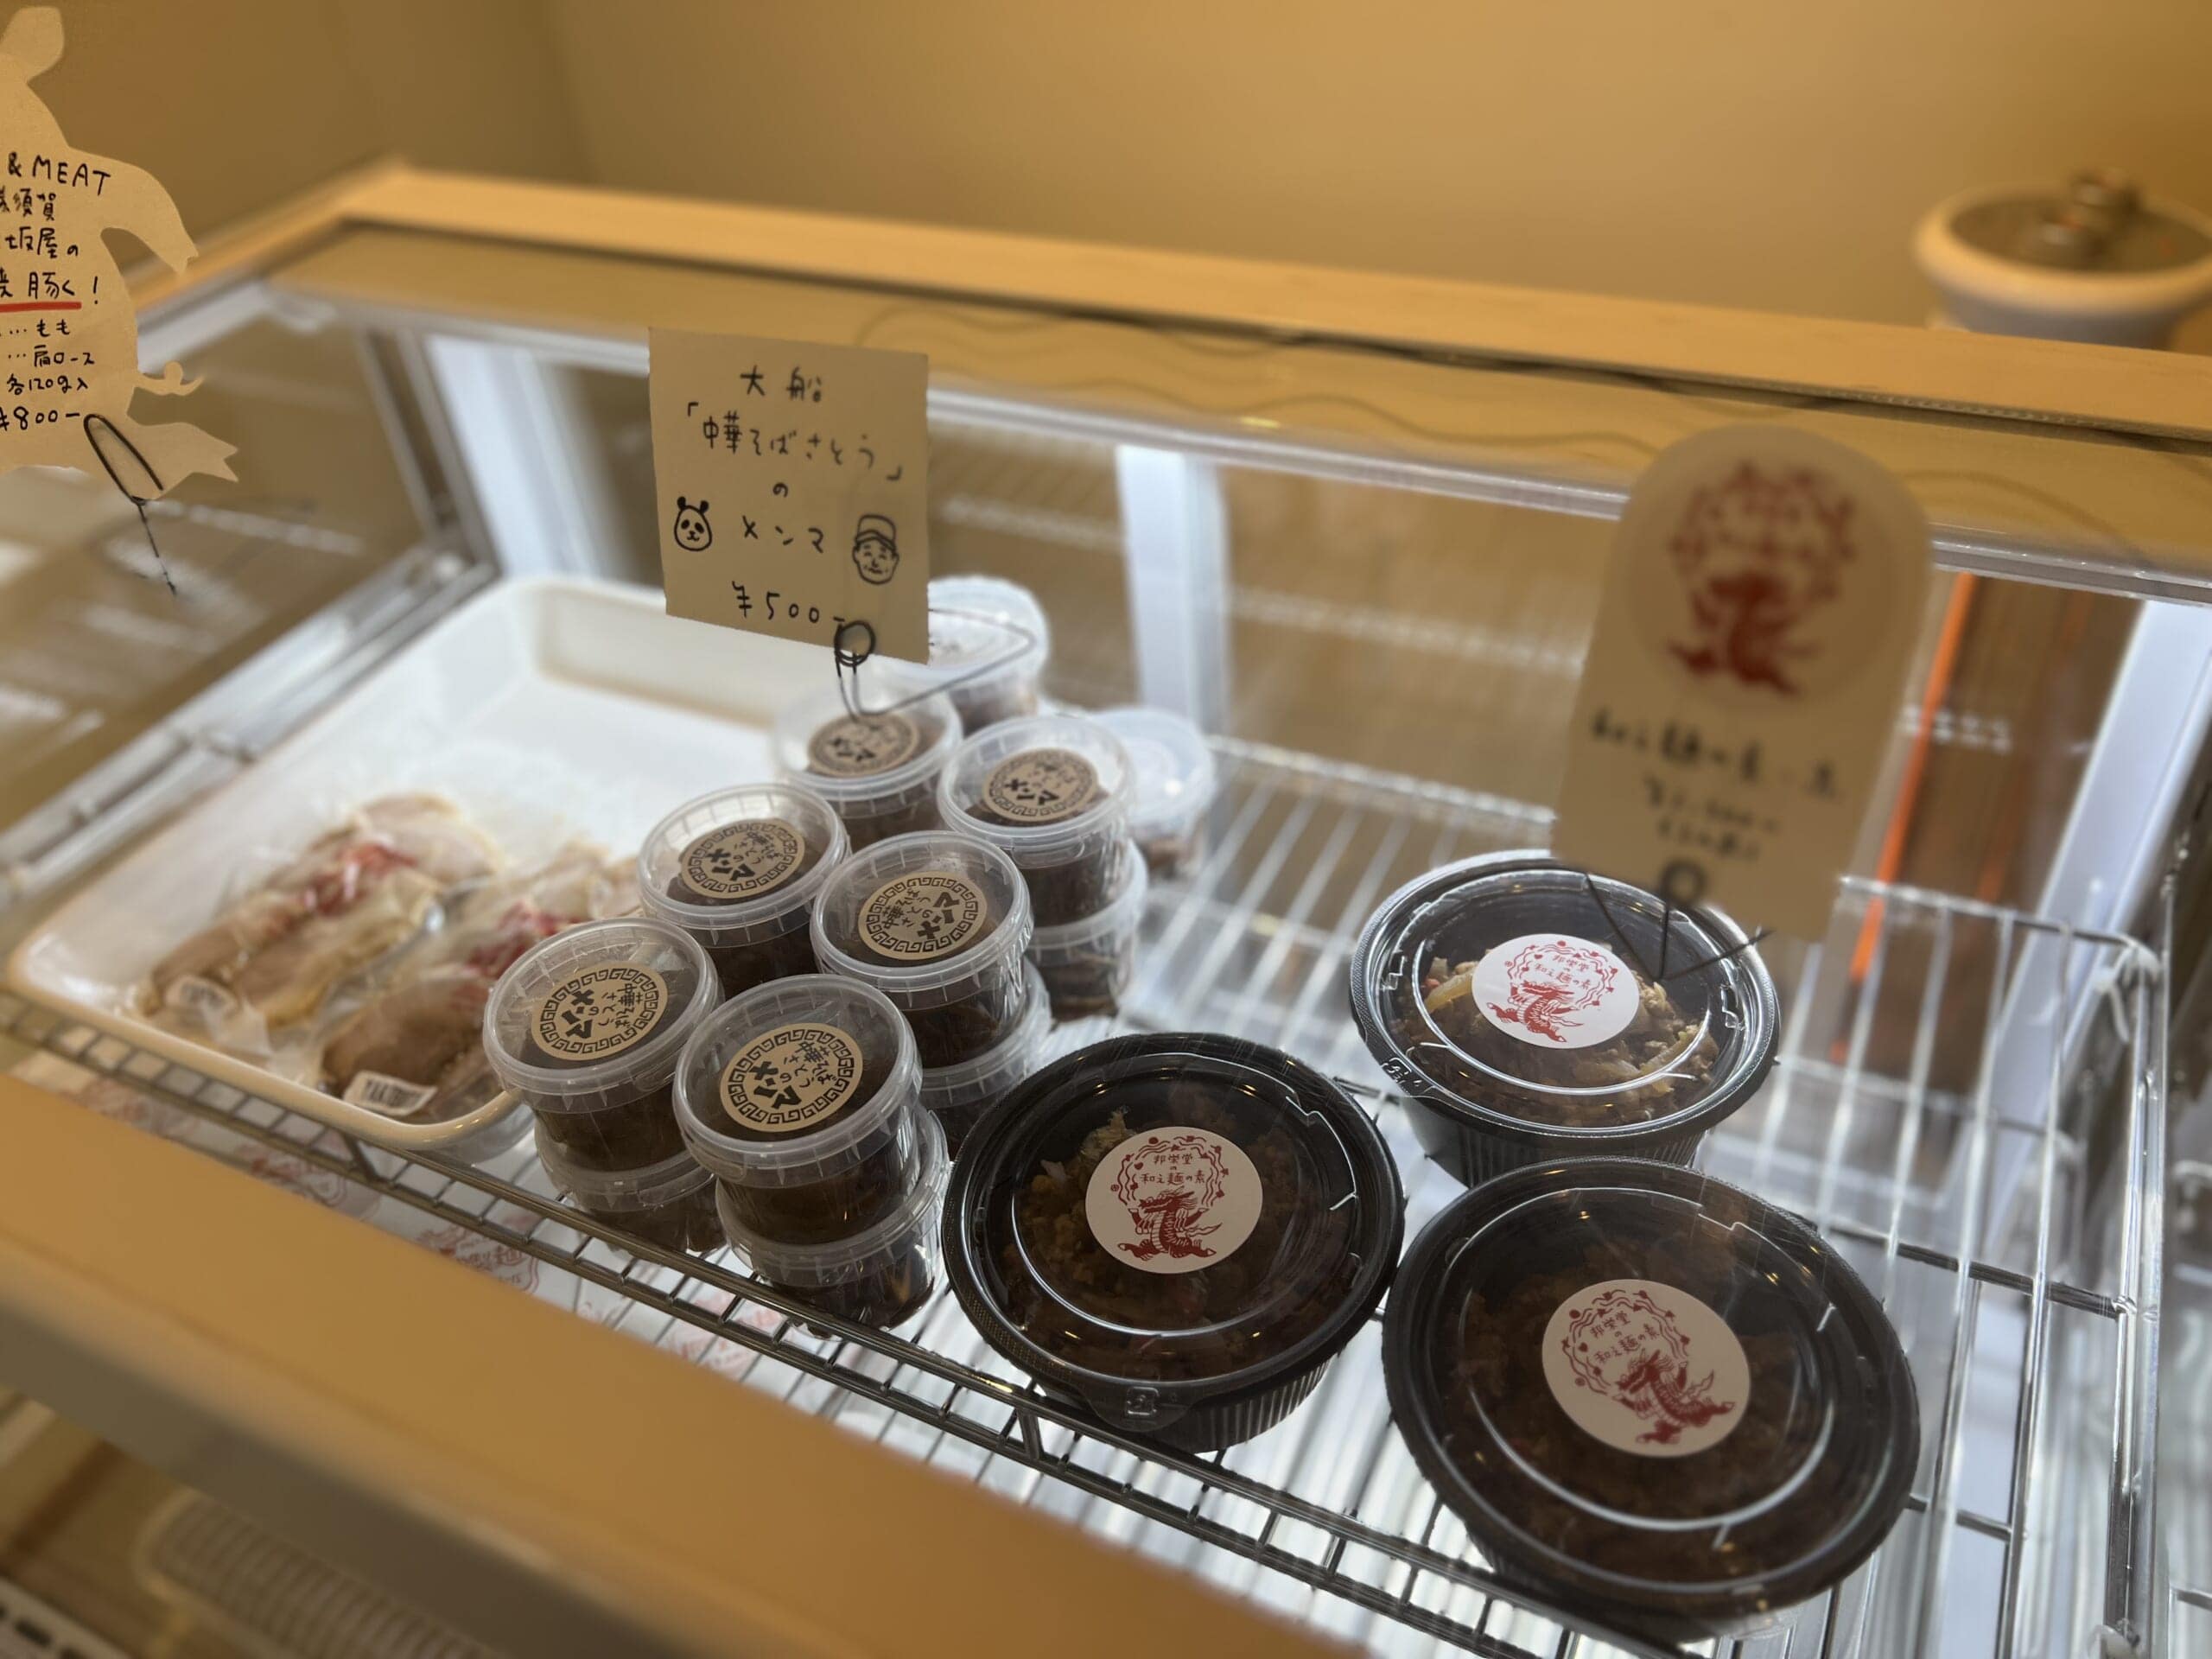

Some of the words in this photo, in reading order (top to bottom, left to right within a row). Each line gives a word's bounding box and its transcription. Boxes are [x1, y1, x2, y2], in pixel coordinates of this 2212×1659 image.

[8, 151, 22, 177] &
[32, 155, 111, 196] MEAT
[740, 365, 823, 403] 大船
[687, 402, 902, 481] 「中華そばさとう」
[772, 482, 789, 498] の
[741, 515, 824, 554] メンマ
[706, 848, 756, 881] メンマ
[917, 892, 961, 940] メンマ
[561, 989, 595, 1039] メンマ
[747, 1060, 803, 1109] メンマ
